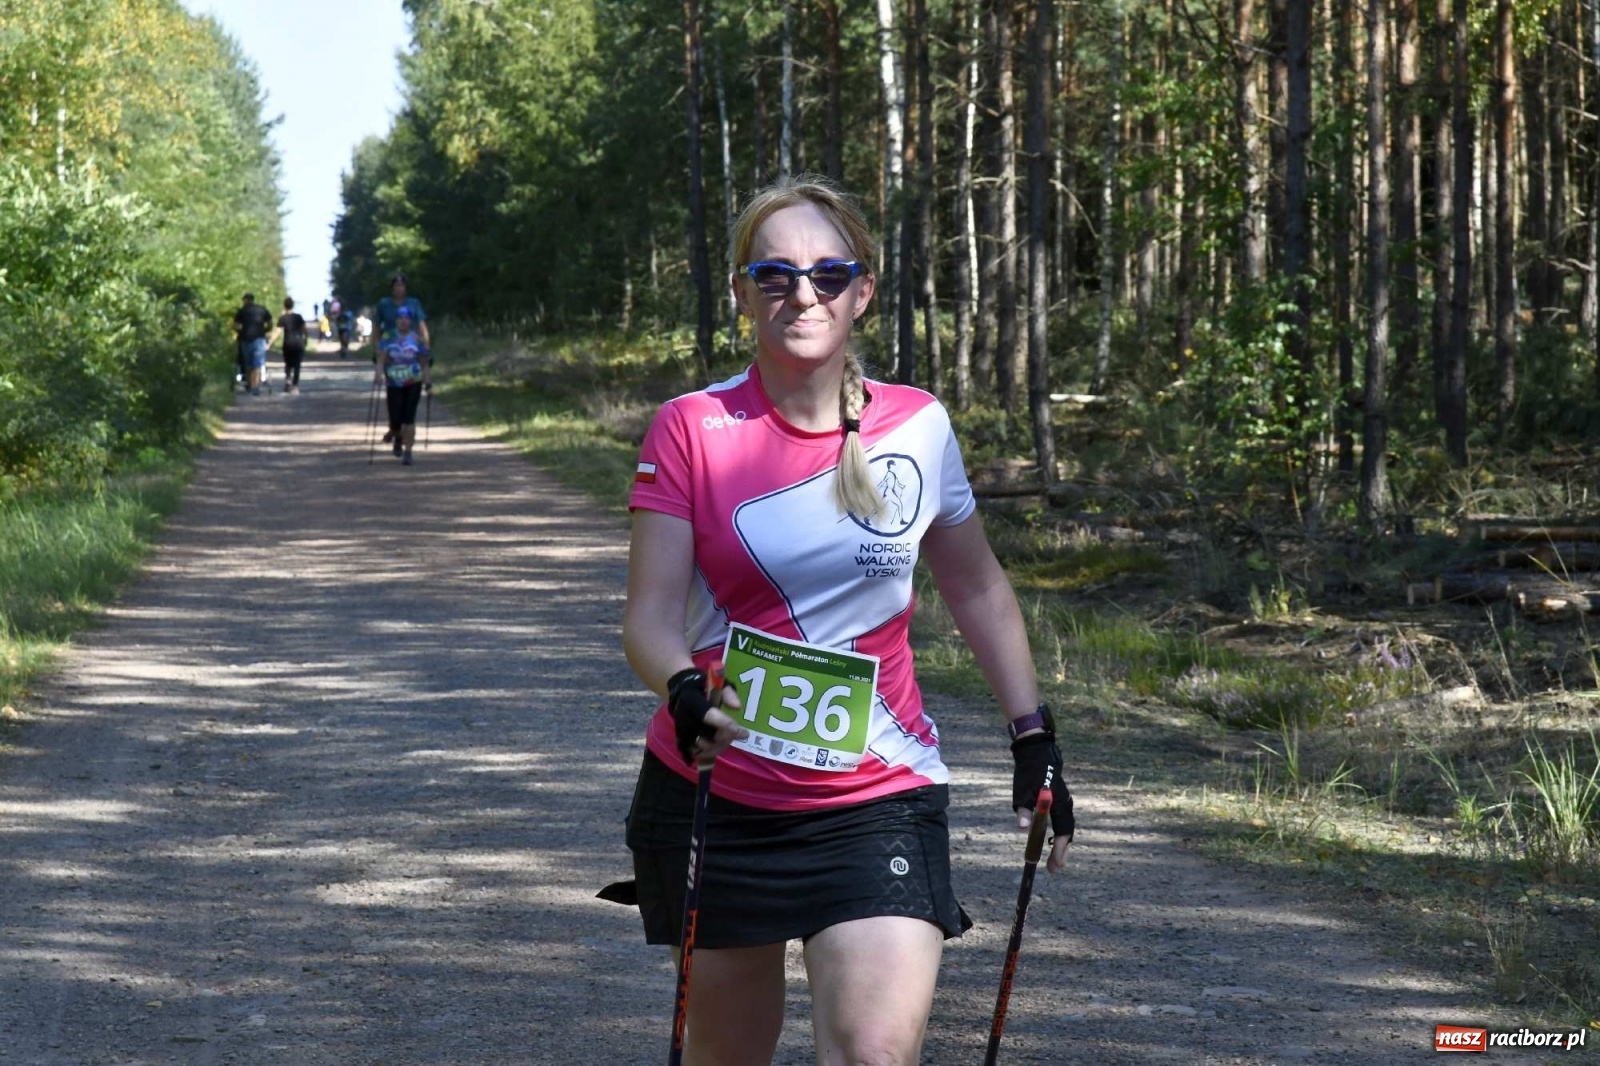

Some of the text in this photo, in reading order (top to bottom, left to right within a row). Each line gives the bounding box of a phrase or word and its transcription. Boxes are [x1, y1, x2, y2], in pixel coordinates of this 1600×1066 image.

[859, 542, 911, 553] NORDIC
[854, 555, 911, 566] WALKING
[865, 568, 901, 578] LYSKI
[752, 648, 783, 663] RAFAMET
[791, 650, 829, 663] Półmaraton
[738, 666, 852, 742] 136
